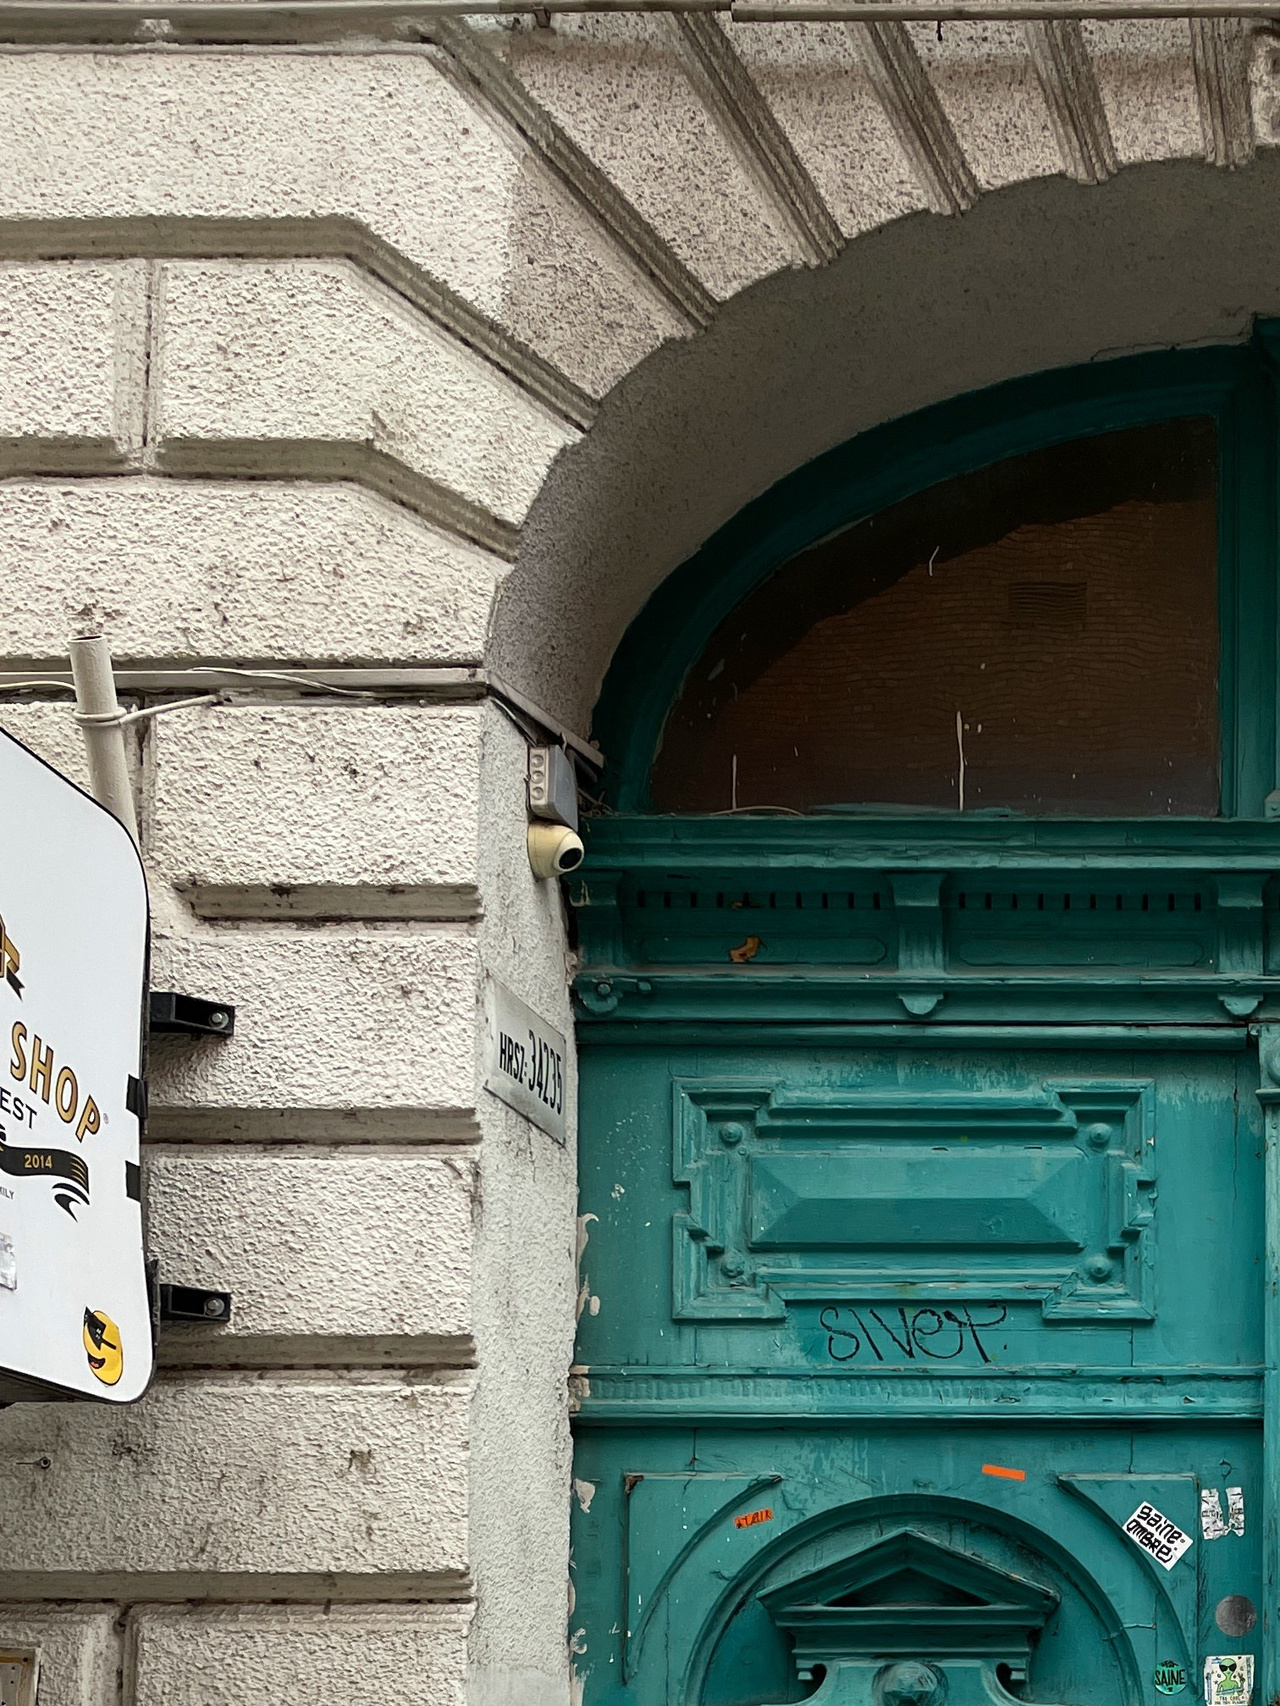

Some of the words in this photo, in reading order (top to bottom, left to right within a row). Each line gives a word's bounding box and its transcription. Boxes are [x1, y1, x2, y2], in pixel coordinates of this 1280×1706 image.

[10, 1020, 102, 1143] SHOP
[499, 1031, 528, 1085] HRSZ:
[528, 1028, 563, 1115] 34235
[24, 1154, 53, 1169] 2014
[1154, 1668, 1186, 1686] SAINE
